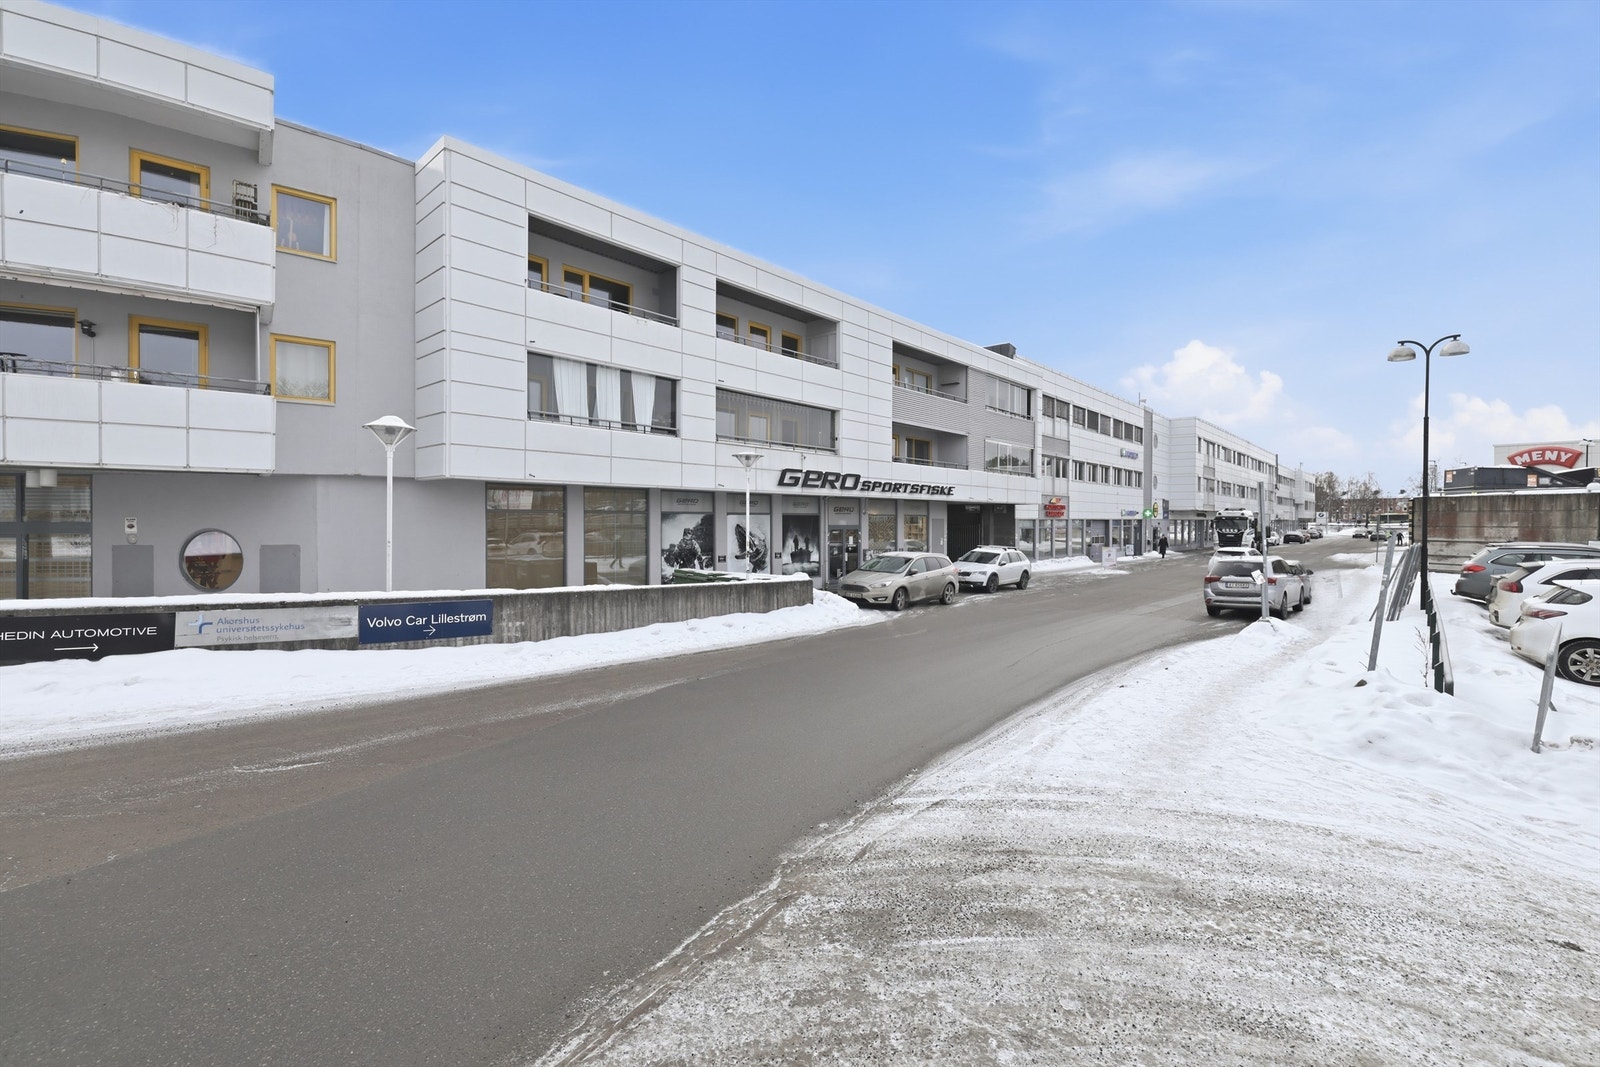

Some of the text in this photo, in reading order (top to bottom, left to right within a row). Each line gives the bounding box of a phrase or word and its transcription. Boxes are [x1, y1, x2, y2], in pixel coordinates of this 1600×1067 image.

[1514, 450, 1573, 465] MENY
[860, 480, 956, 496] SPORTSFISKE
[367, 612, 487, 628] Volvo Car Lillestrøm
[50, 626, 158, 639] AUTOMOTIVE
[216, 623, 305, 634] universitetssykehus
